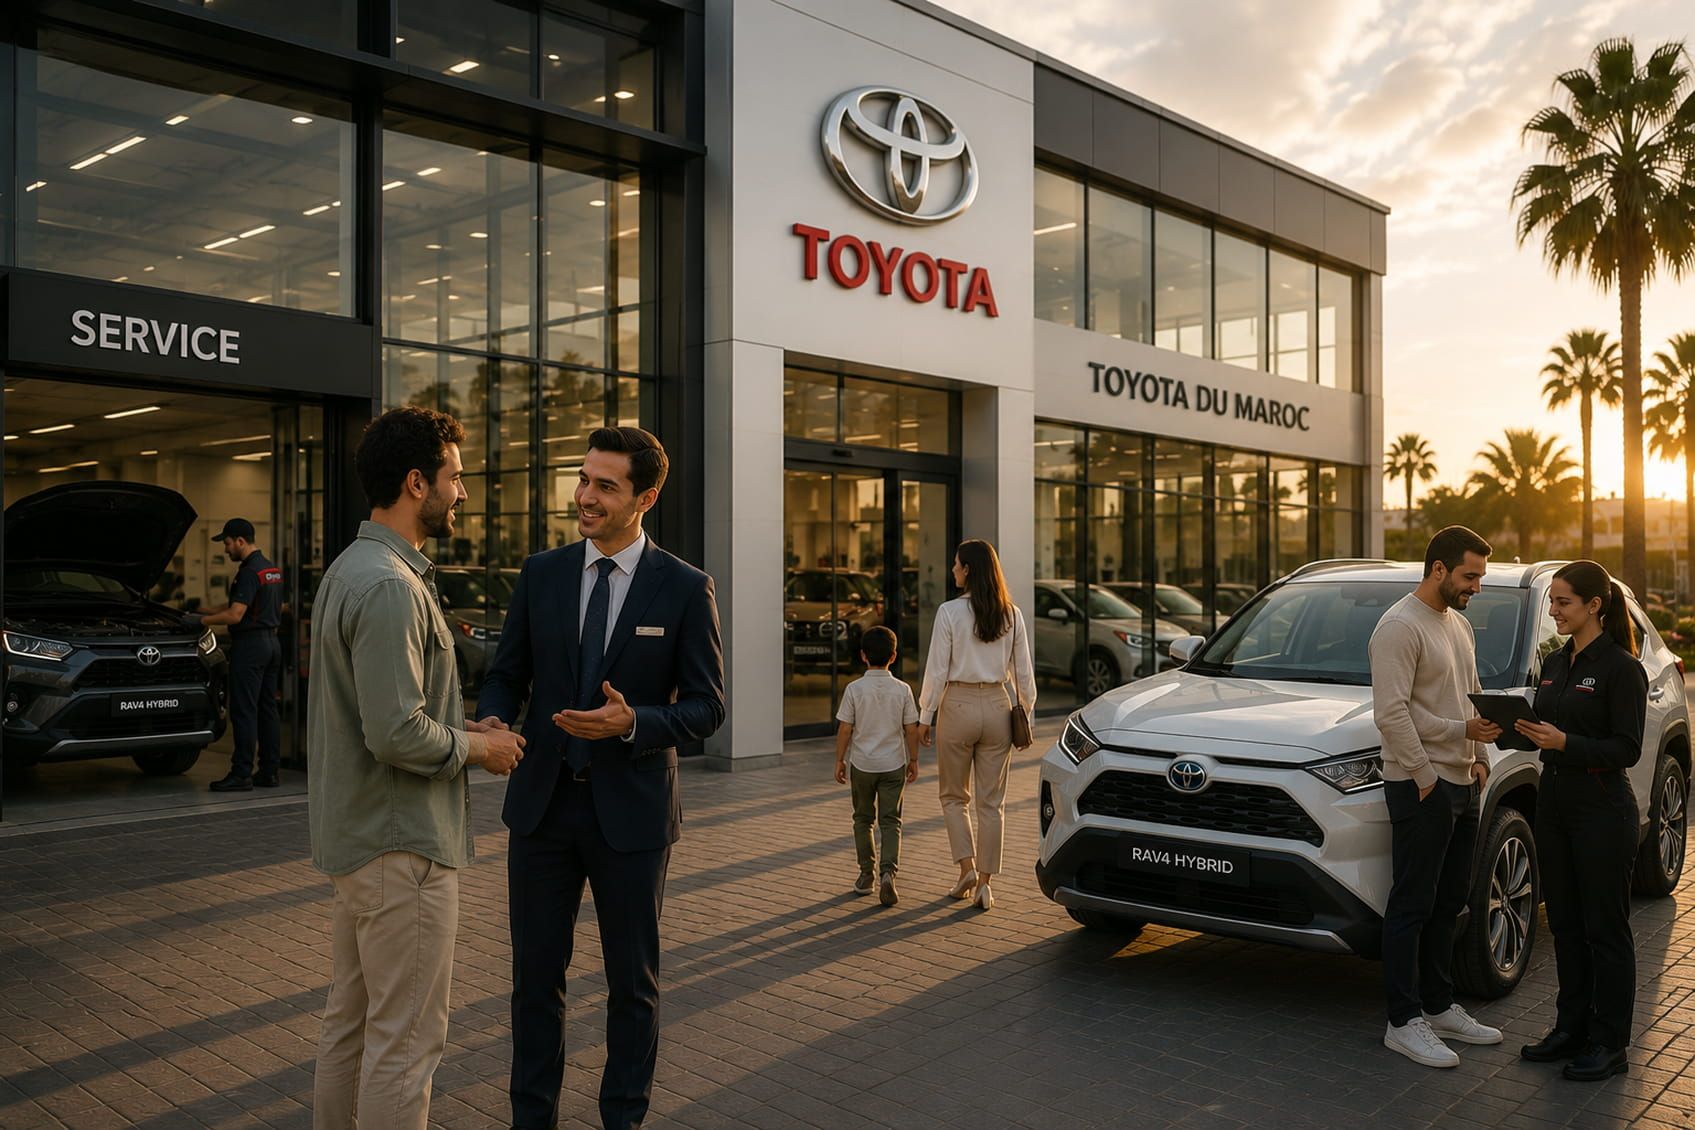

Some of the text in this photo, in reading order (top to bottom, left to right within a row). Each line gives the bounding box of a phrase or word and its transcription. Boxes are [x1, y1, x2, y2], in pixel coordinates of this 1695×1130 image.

[792, 223, 999, 318] TOYOTA
[71, 309, 240, 364] SERVICE
[1088, 362, 1310, 432] TOYOTA DU MAROC
[120, 699, 179, 710] RAV4 HYBRID
[1132, 847, 1234, 874] RAV4 HYBRID
